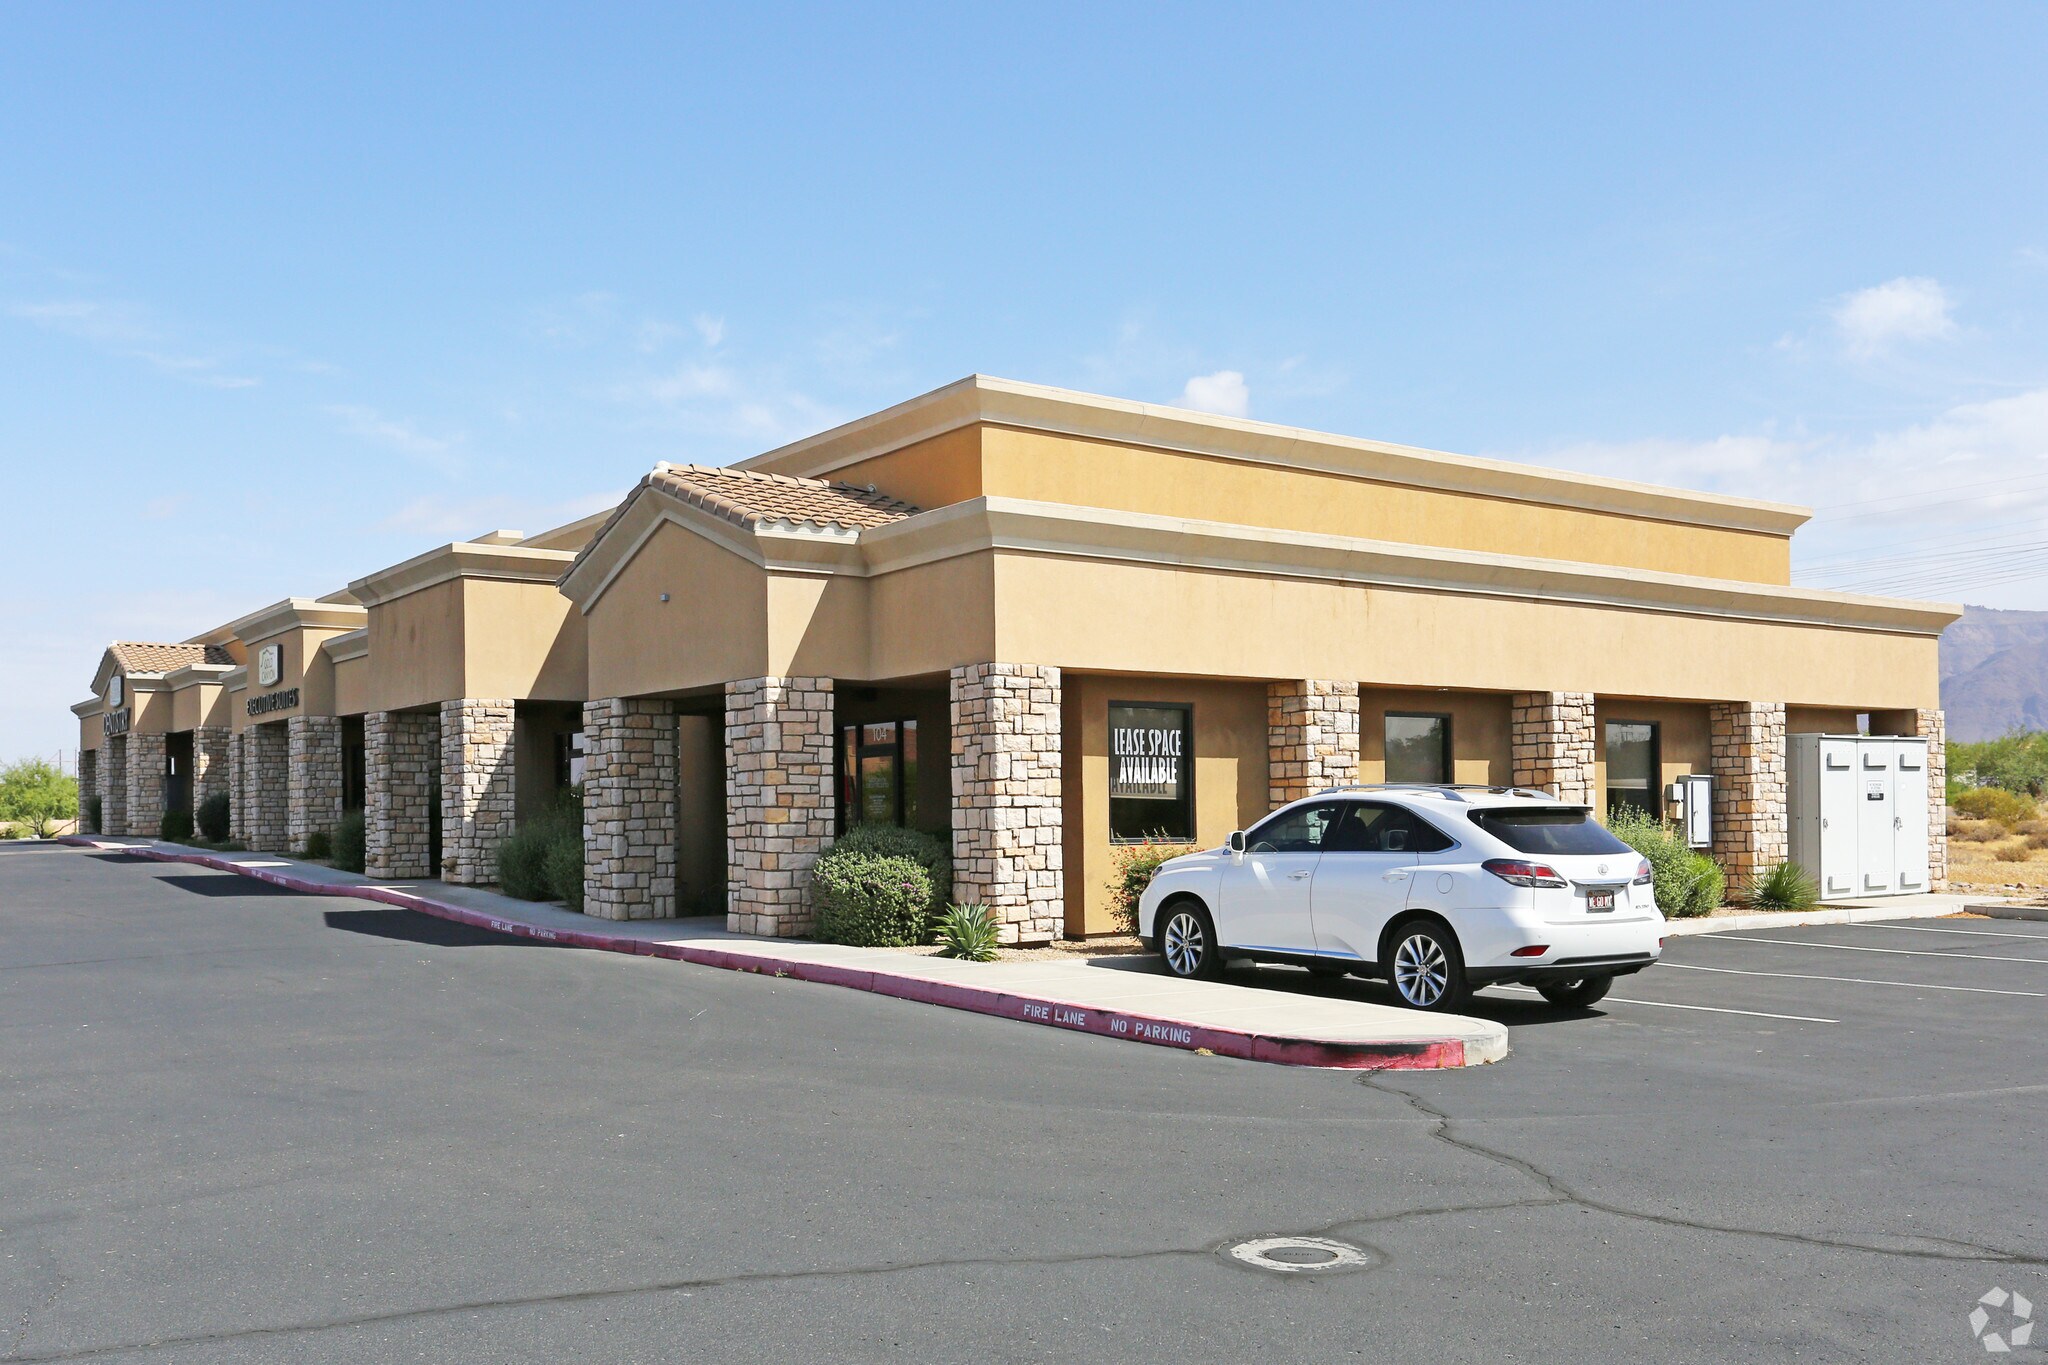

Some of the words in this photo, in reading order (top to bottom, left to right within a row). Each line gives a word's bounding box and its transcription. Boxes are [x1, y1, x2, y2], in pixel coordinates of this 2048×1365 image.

[246, 691, 276, 716] EXECUTIVE
[275, 688, 299, 710] SUITES
[103, 706, 131, 736] DENTISTRY
[873, 727, 887, 742] 104
[1114, 728, 1145, 755] LEASE
[1148, 729, 1181, 756] SPACE
[1119, 756, 1177, 784] AVAILABLE
[490, 920, 501, 930] FIRE
[501, 922, 513, 933] LANE
[529, 928, 536, 936] NO
[537, 929, 556, 940] PARKING
[1023, 1003, 1049, 1020] FIRE
[1054, 1009, 1086, 1026] LANE
[1111, 1018, 1127, 1033] NO
[1135, 1022, 1191, 1044] PARKING
